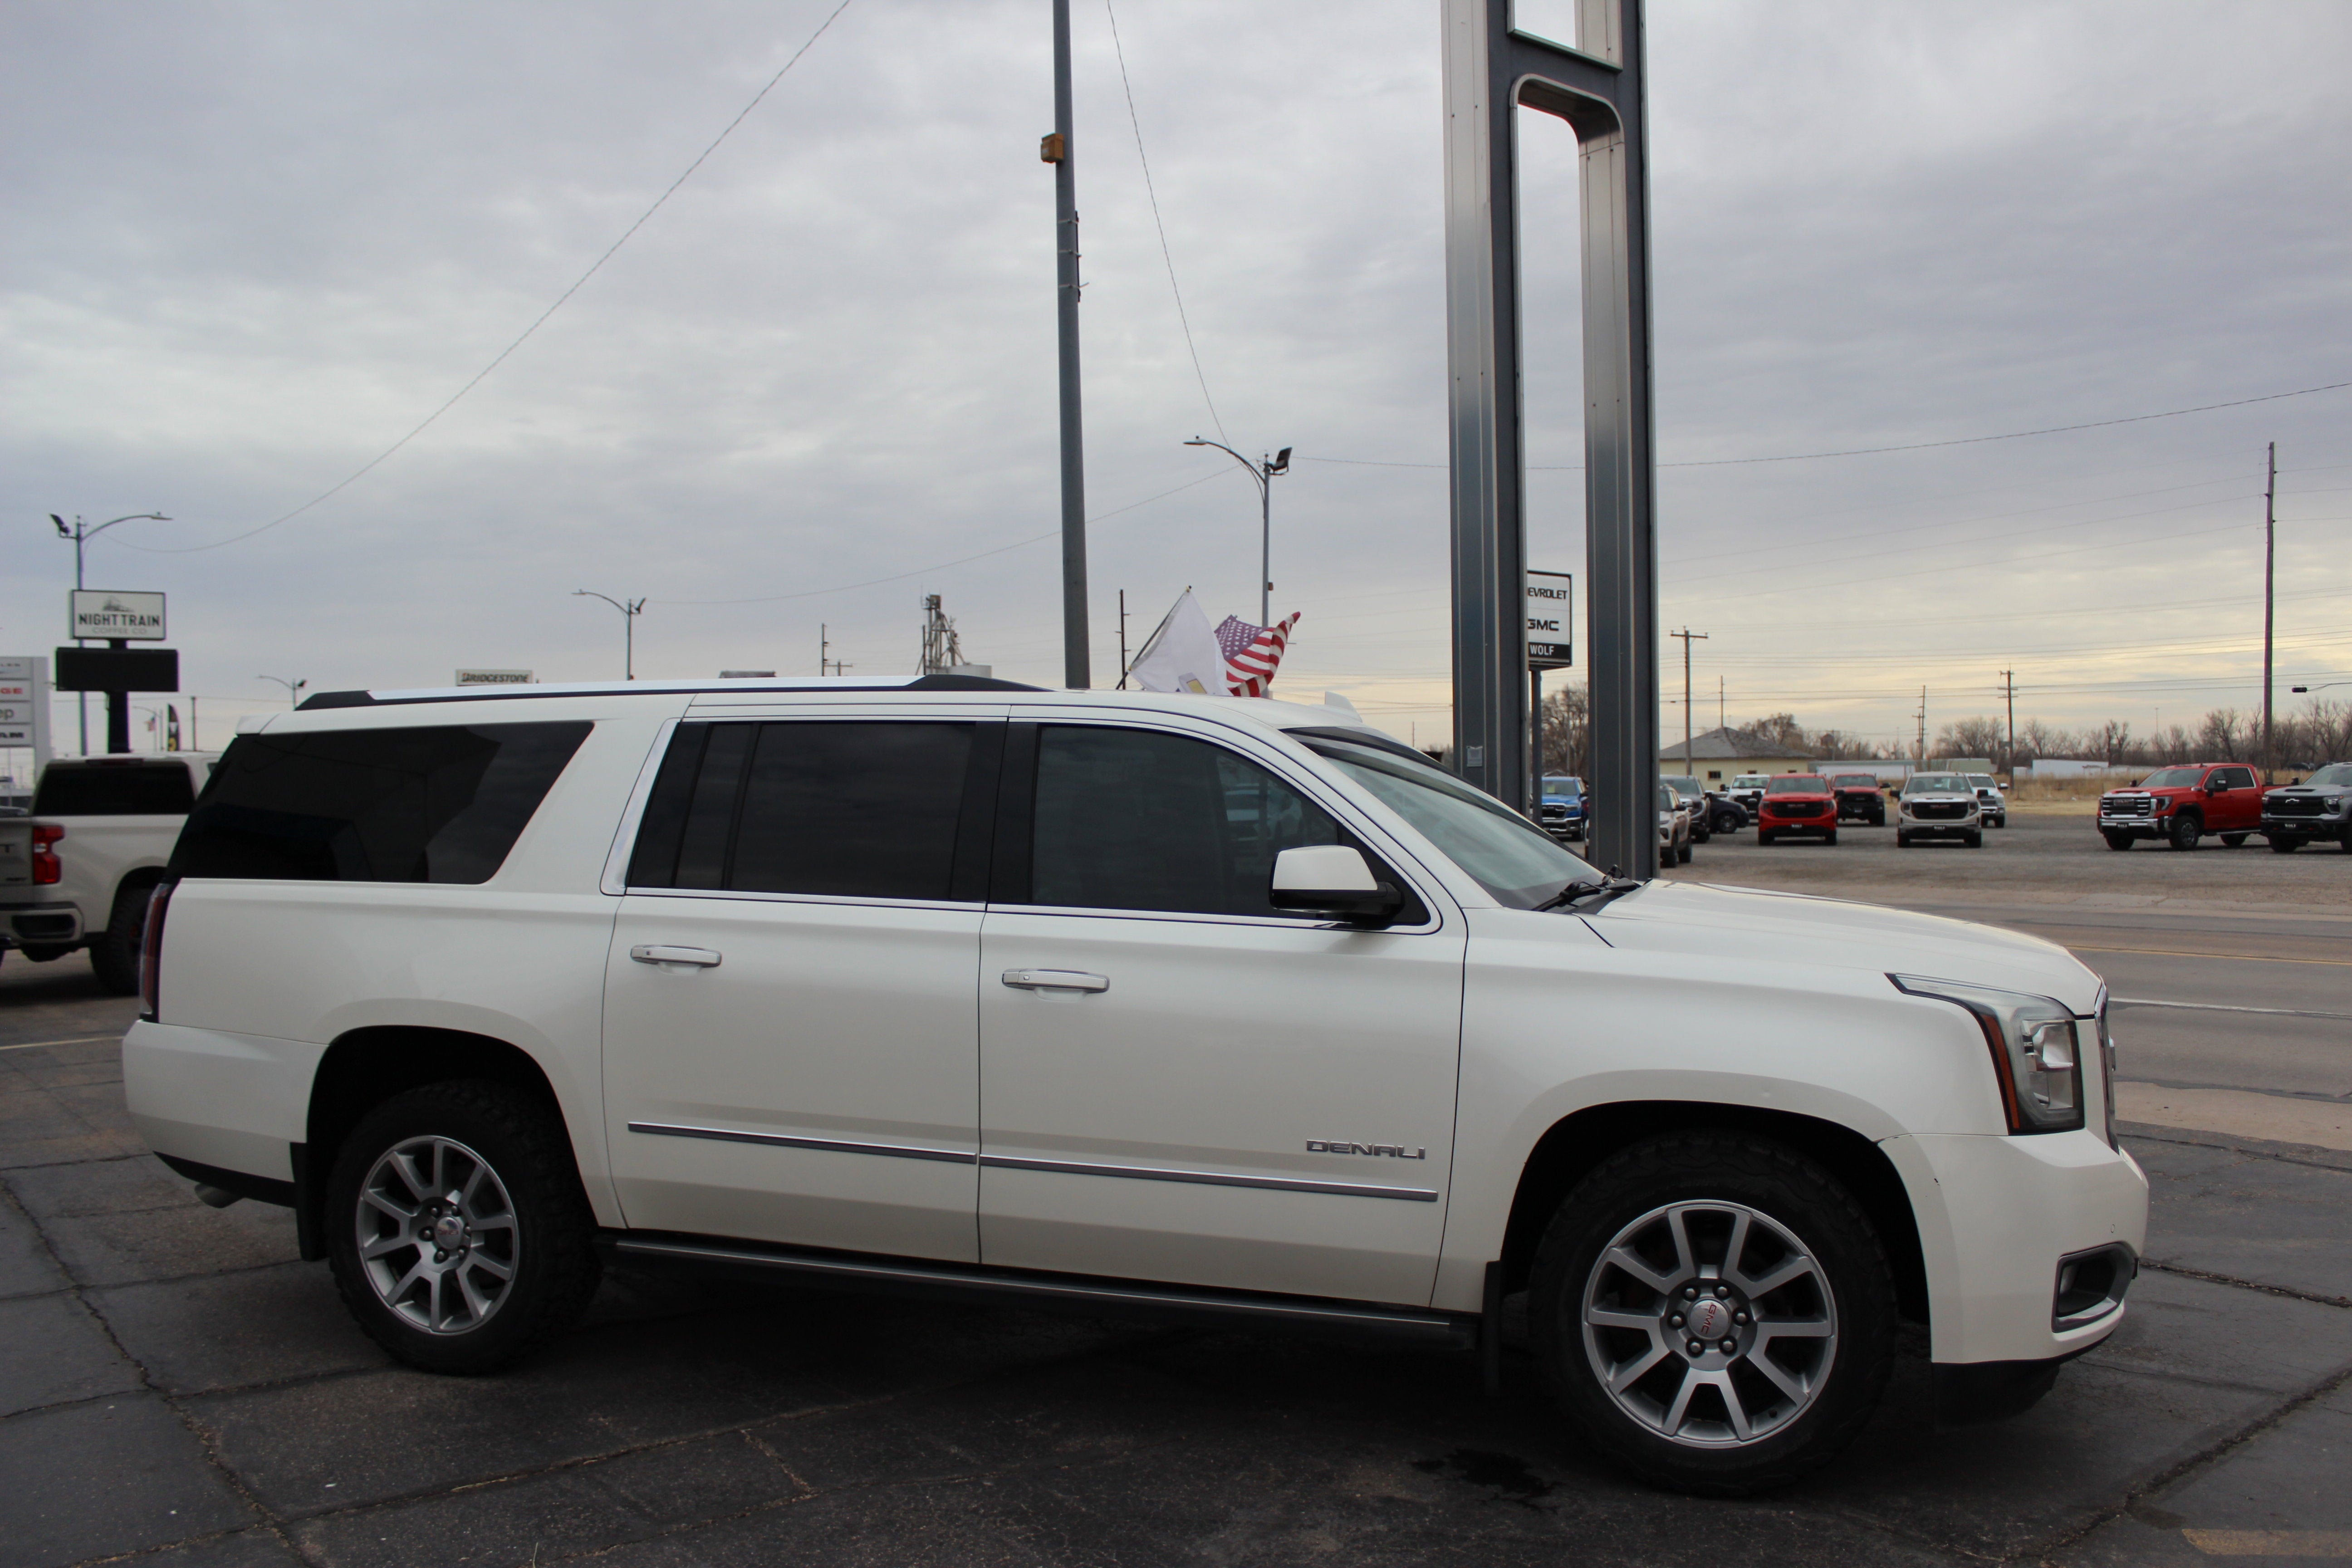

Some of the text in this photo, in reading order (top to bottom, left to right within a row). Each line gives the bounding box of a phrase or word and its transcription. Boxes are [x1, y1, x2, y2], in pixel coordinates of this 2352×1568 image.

[79, 613, 161, 627] NIGHT TRAIN
[1528, 618, 1559, 631] GMC
[1529, 644, 1554, 656] WOLF
[462, 672, 529, 682] BRIDGESTONE
[1306, 1139, 1426, 1160] DENALI
[1701, 1303, 1717, 1335] GMC
